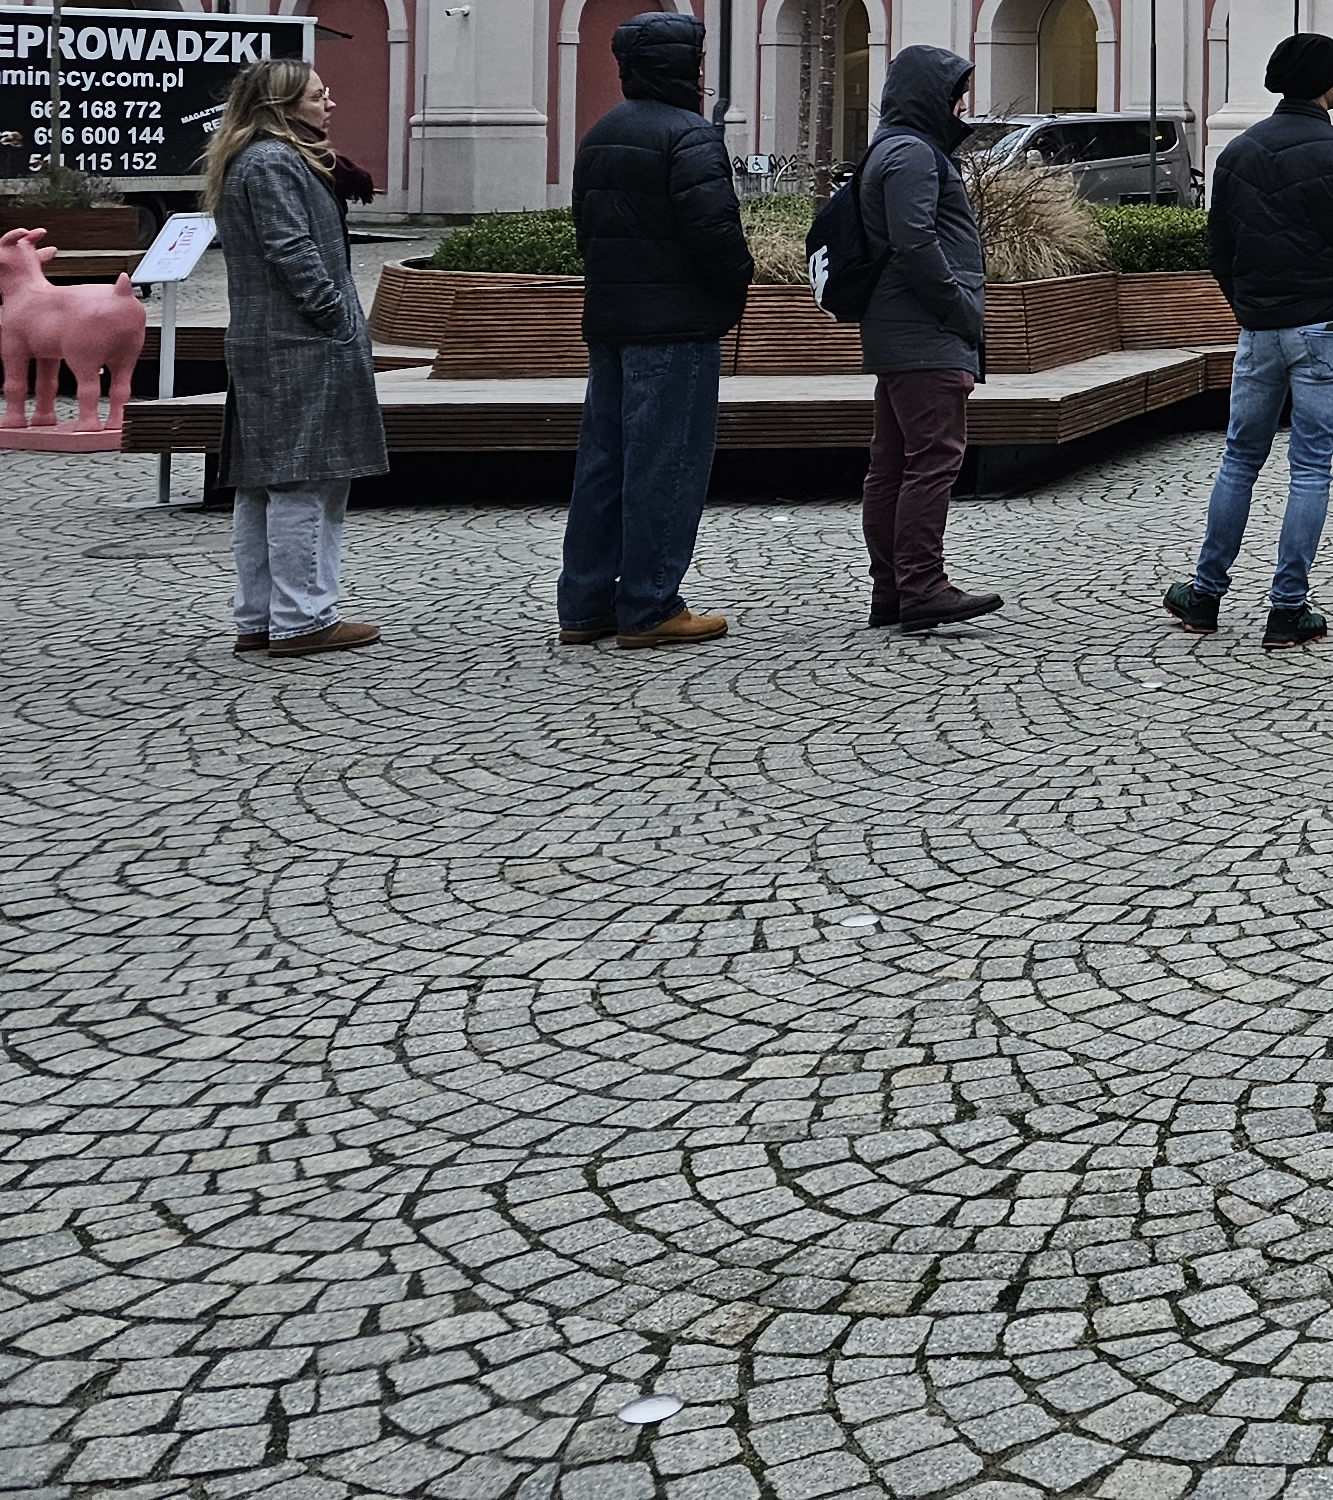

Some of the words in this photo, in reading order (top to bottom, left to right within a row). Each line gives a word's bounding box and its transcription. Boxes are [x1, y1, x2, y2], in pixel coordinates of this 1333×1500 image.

[0, 65, 184, 93] minscy.com.pl
[78, 101, 117, 119] 168
[123, 101, 162, 119] 772
[81, 126, 120, 145] 600
[127, 126, 166, 145] 144
[75, 152, 113, 171] 115
[119, 152, 157, 171] 152
